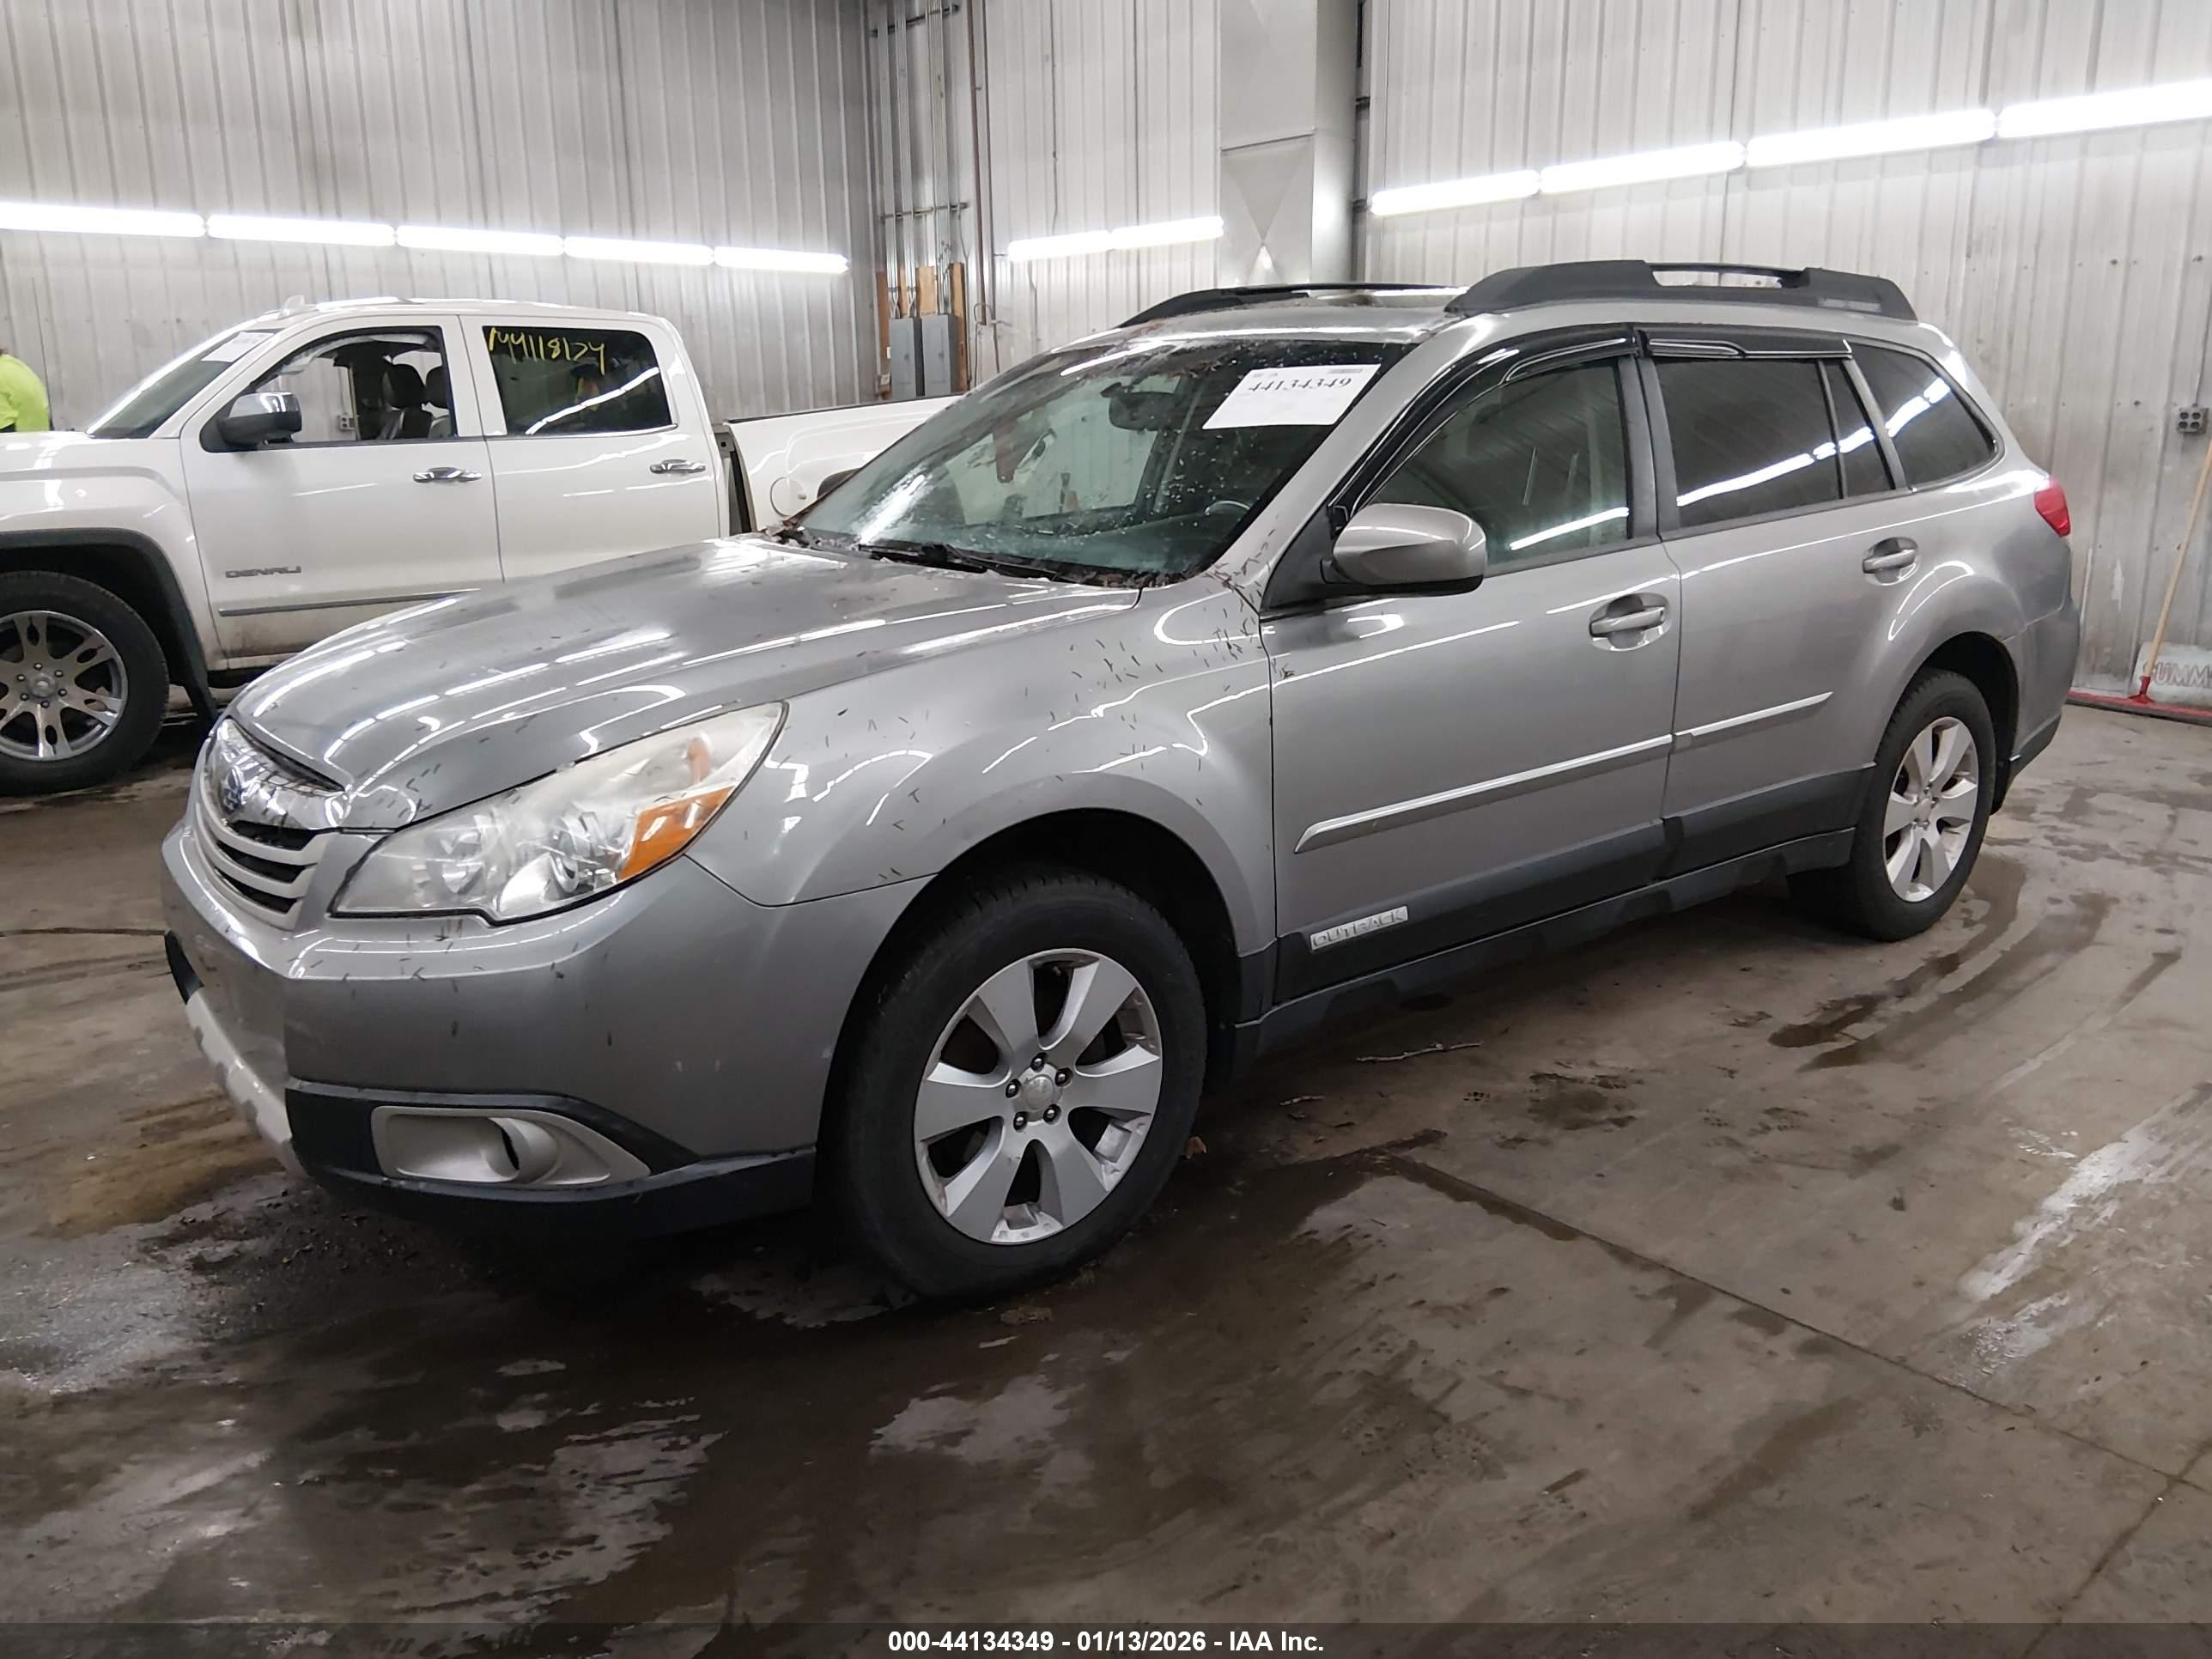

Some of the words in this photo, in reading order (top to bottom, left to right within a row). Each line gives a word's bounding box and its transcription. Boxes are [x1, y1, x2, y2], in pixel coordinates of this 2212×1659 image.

[1248, 377, 1352, 392] 44134349
[225, 565, 302, 579] DENALI
[1312, 908, 1407, 947] OUTBACK
